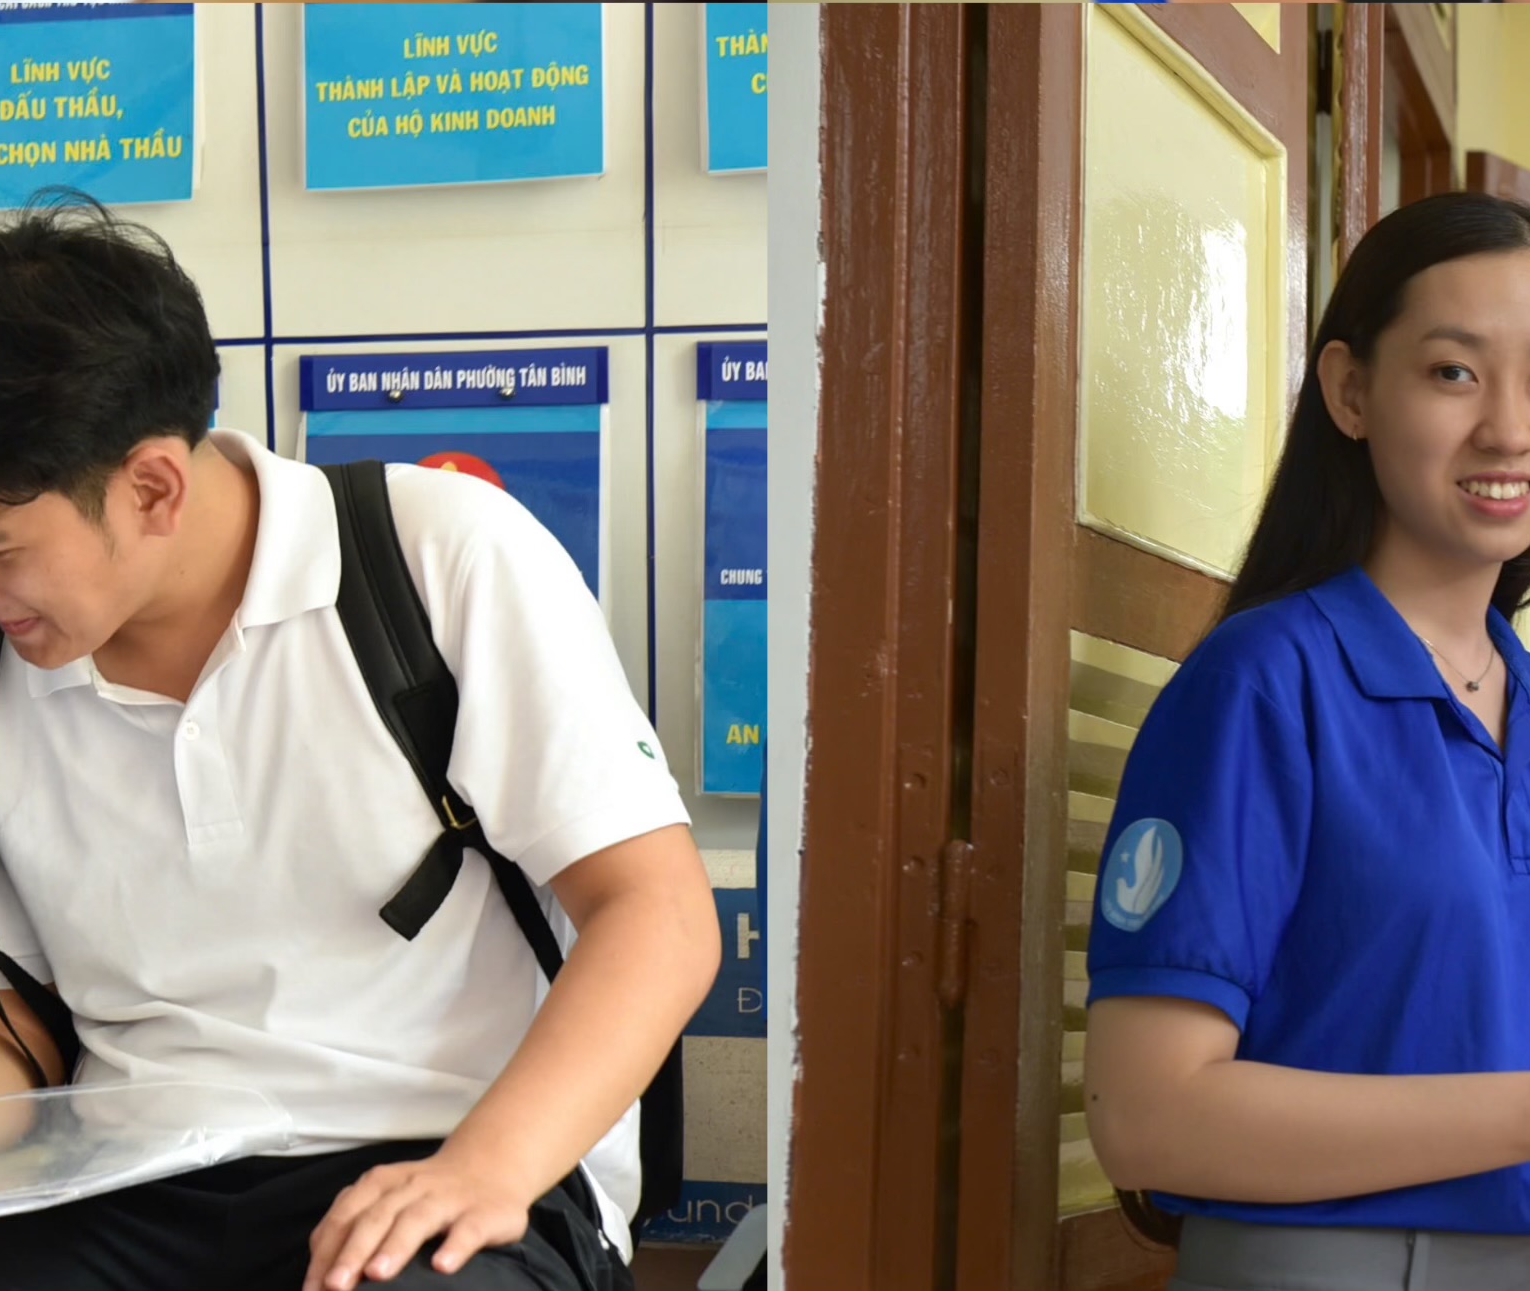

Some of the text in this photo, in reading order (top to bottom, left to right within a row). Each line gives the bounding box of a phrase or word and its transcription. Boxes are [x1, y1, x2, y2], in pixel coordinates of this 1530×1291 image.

[403, 30, 498, 59] LĨNH VỰC
[10, 56, 111, 85] LĨNH VỰC
[316, 61, 589, 102] THÀNH LẬP VÀ HOẠT ĐỘNG
[0, 90, 46, 122] ĐẤU
[348, 105, 555, 138] CỦA HỘ KINH DOANH
[65, 134, 111, 162] NHÀ
[327, 363, 586, 393] ỦY BAN NHÂN DÂN PHƯỜNG TÂN BÌNH
[722, 356, 741, 381] ỦY
[721, 569, 763, 585] CHUNG
[726, 724, 760, 745] AN
